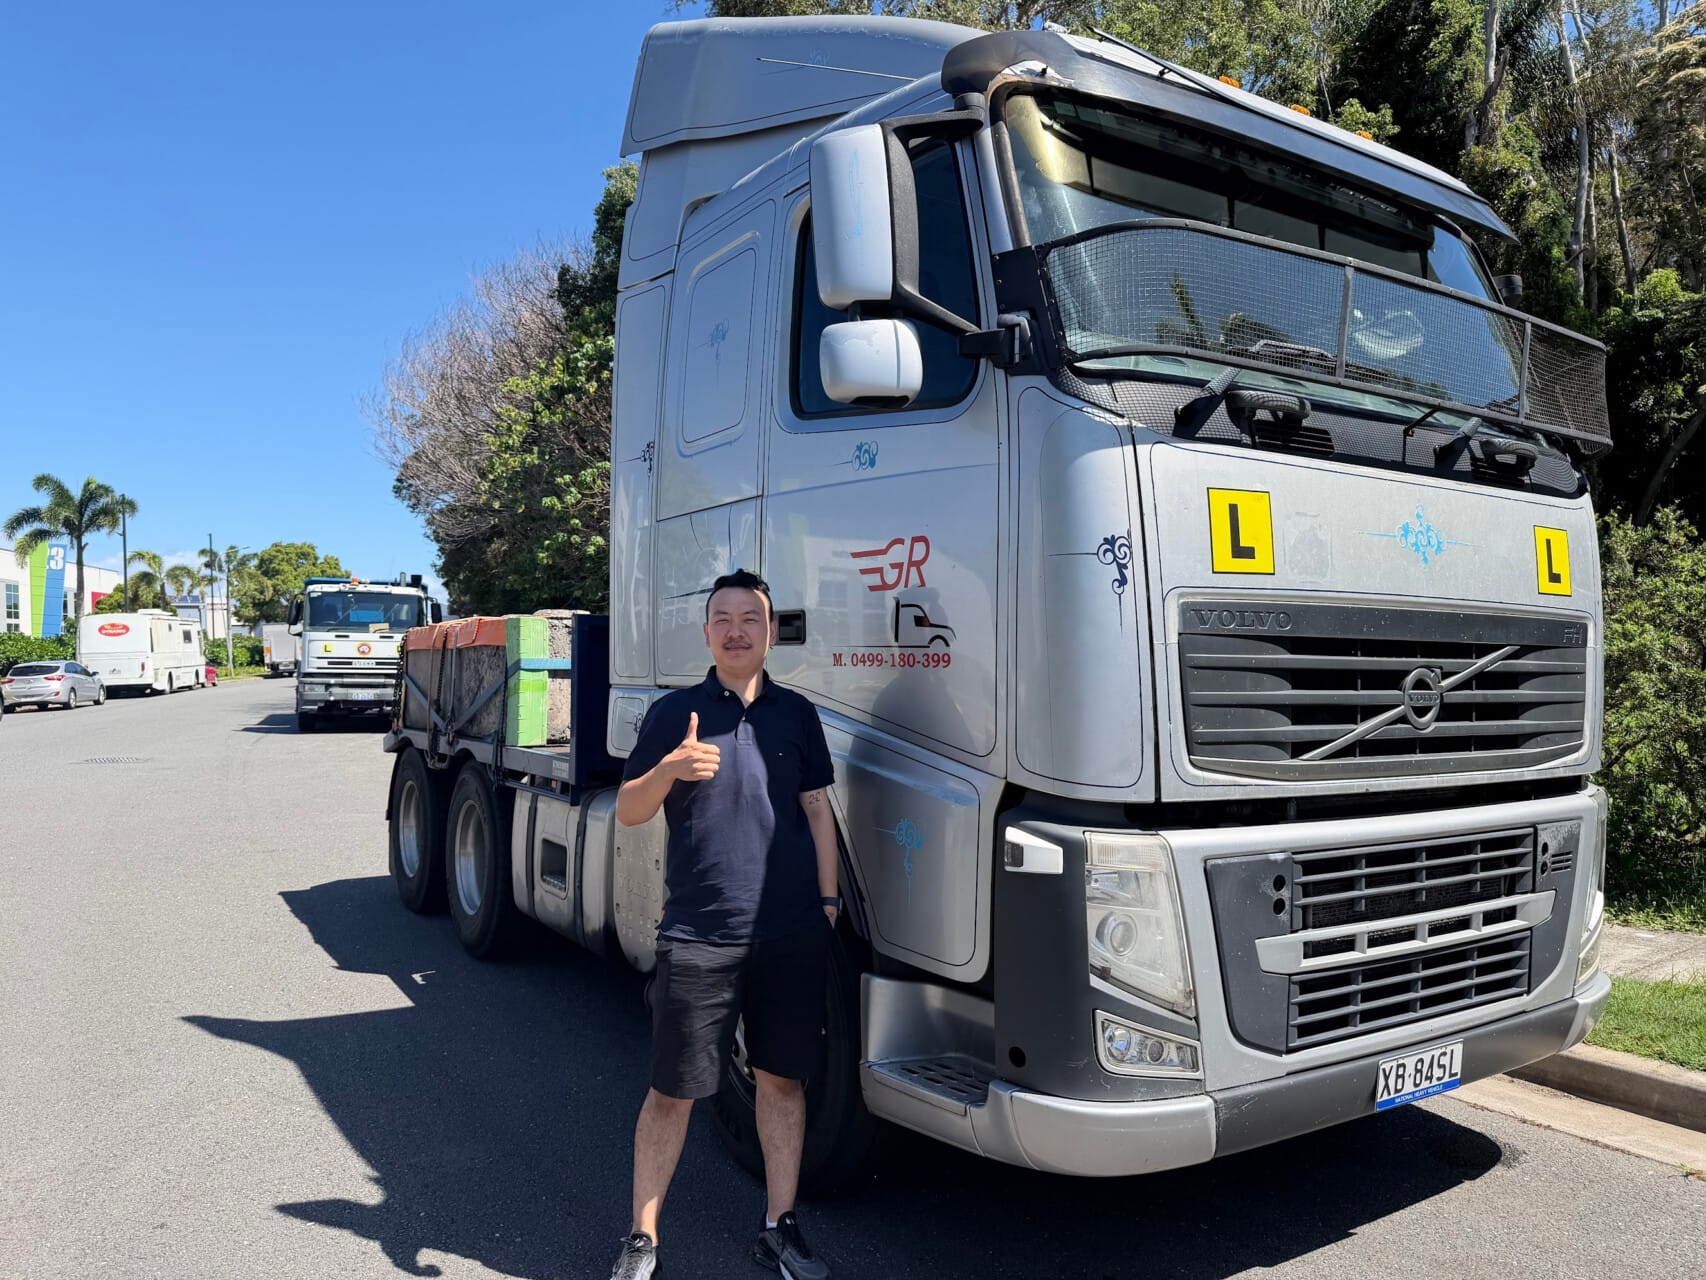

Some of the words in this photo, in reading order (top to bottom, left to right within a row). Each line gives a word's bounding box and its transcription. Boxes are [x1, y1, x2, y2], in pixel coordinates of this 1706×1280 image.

[1228, 503, 1256, 560] L
[850, 535, 930, 592] GR
[1546, 538, 1561, 584] L
[1190, 608, 1292, 631] VOLVO
[1563, 624, 1583, 643] FH
[324, 644, 332, 652] L
[832, 653, 847, 667] M.
[851, 652, 951, 668] 0499-180-399
[1408, 694, 1439, 704] VOLVO
